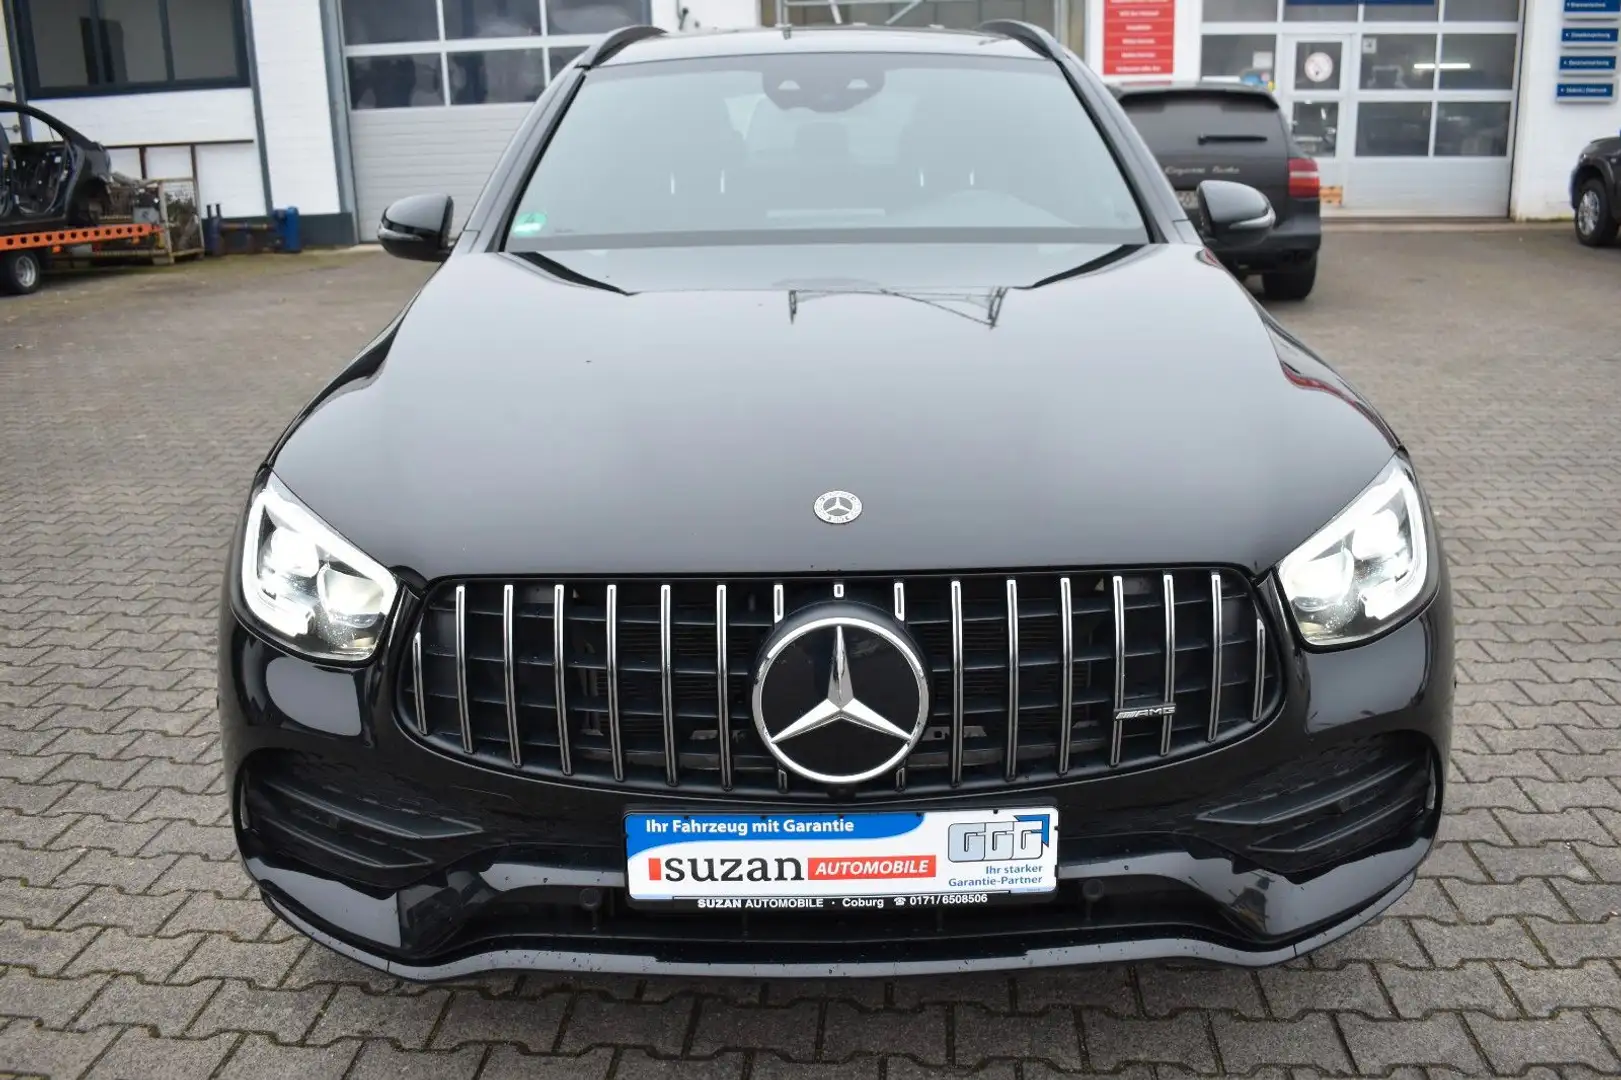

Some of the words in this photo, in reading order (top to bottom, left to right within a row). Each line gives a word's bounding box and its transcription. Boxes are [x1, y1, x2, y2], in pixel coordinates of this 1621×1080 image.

[646, 819, 669, 833] Ihr
[672, 819, 748, 836] Fahrzeug
[752, 819, 780, 833] mit
[783, 818, 855, 833] Garantie
[664, 856, 805, 883] suzan
[815, 859, 929, 876] AUTOMOBILE
[985, 865, 1002, 875] Ihr
[1004, 864, 1043, 875] starker
[948, 875, 1043, 887] Garantie-Partner
[697, 899, 742, 909] SUZAN
[745, 898, 824, 908] AUTOMOBILE
[842, 897, 884, 909] Coburg
